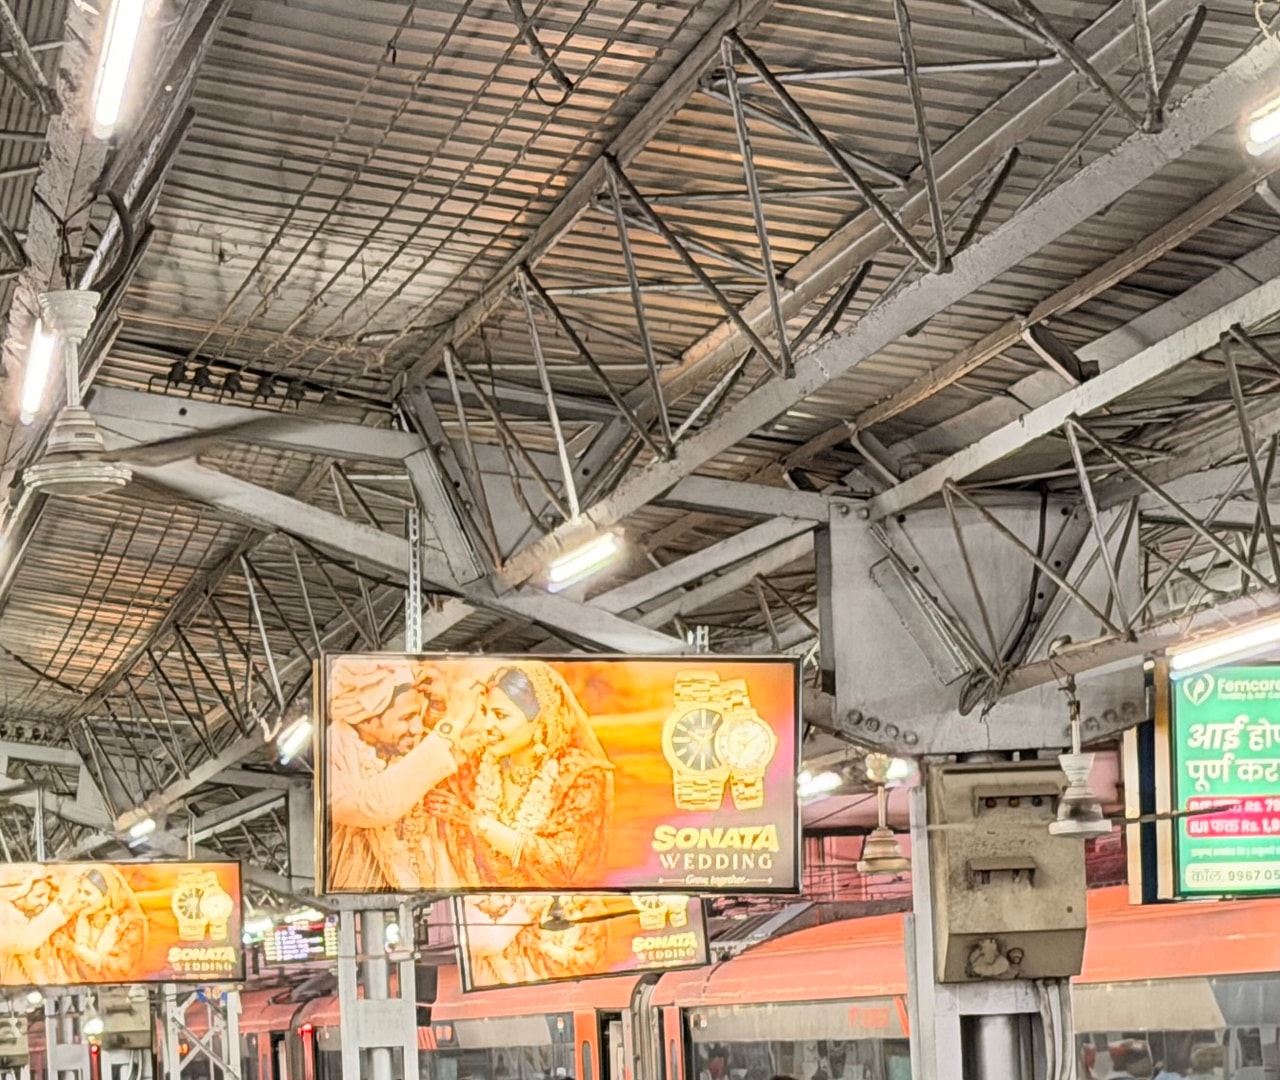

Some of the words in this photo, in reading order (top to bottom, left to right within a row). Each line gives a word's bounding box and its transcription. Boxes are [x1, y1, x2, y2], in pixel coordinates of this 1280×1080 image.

[1186, 714, 1249, 751] आई
[1185, 752, 1235, 792] पूर्ण
[651, 824, 780, 852] SONATA
[659, 853, 773, 870] WEDDING
[631, 931, 698, 952] SONATA
[167, 946, 236, 963] SONATA
[636, 948, 696, 961] WEDDING
[172, 960, 233, 972] WEDDING
